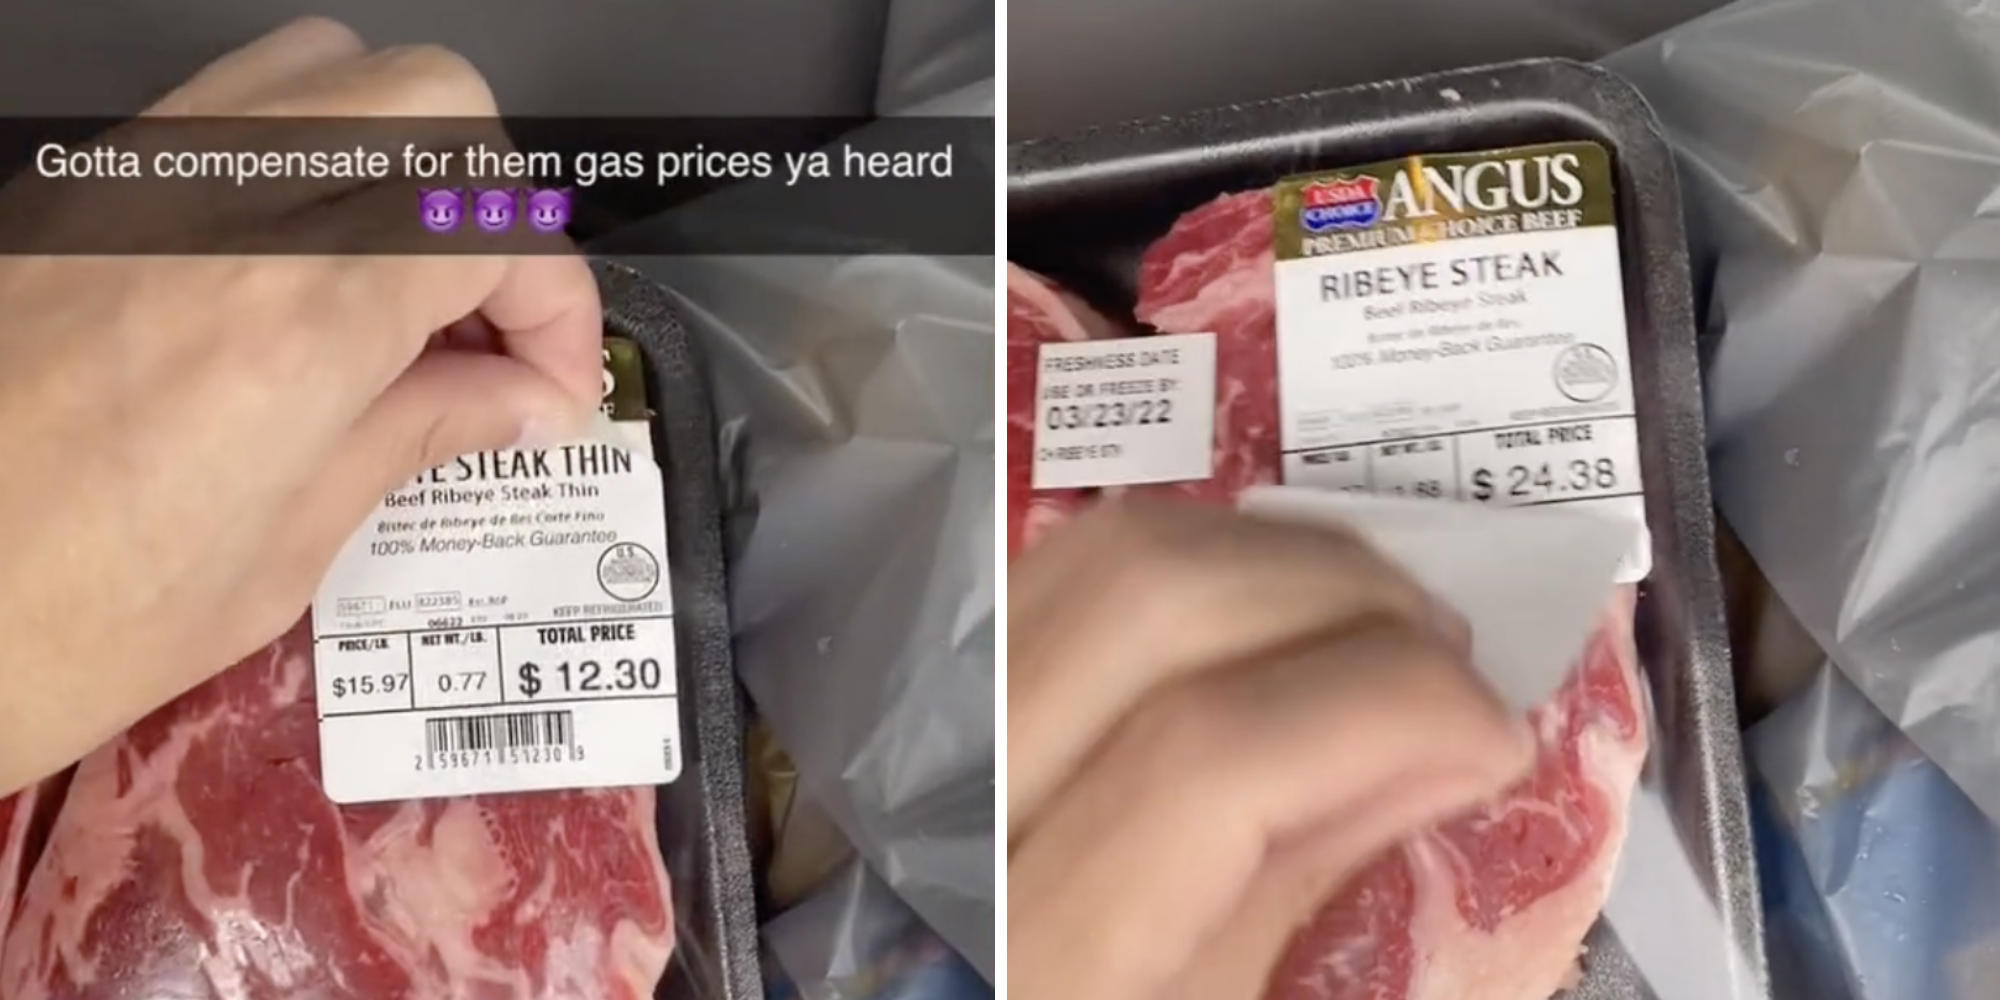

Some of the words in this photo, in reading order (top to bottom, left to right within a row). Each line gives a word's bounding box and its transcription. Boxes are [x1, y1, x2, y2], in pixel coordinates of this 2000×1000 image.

[1313, 184, 1367, 204] USDA
[1382, 152, 1584, 221] ANGUS
[1306, 202, 1374, 222] CHOICE
[1302, 228, 1415, 256] PREMIUM
[1519, 209, 1583, 230] BEEF
[1320, 262, 1439, 302] RIBEYE
[1450, 251, 1564, 287] STEAK
[1047, 398, 1173, 430] 03/23/22
[1494, 430, 1542, 450] TOTAL
[1549, 423, 1593, 444] PRICE
[456, 448, 551, 482] STEAK
[559, 444, 632, 477] THIN
[384, 491, 426, 509] Beef
[431, 484, 496, 507] Ribeye
[500, 482, 552, 502] Steak
[556, 481, 600, 499] Thin
[1472, 467, 1494, 502] $
[1507, 457, 1618, 497] 24.38
[370, 539, 416, 558] 100%
[419, 532, 526, 555] Money-Back
[529, 527, 618, 548] Guarantee
[421, 633, 443, 646] NET
[537, 626, 586, 645] TOTAL
[589, 623, 636, 643] PRICE
[332, 672, 409, 699] $15.97
[437, 671, 488, 694] 0.77
[518, 660, 543, 698] $
[556, 657, 662, 693] 12.30
